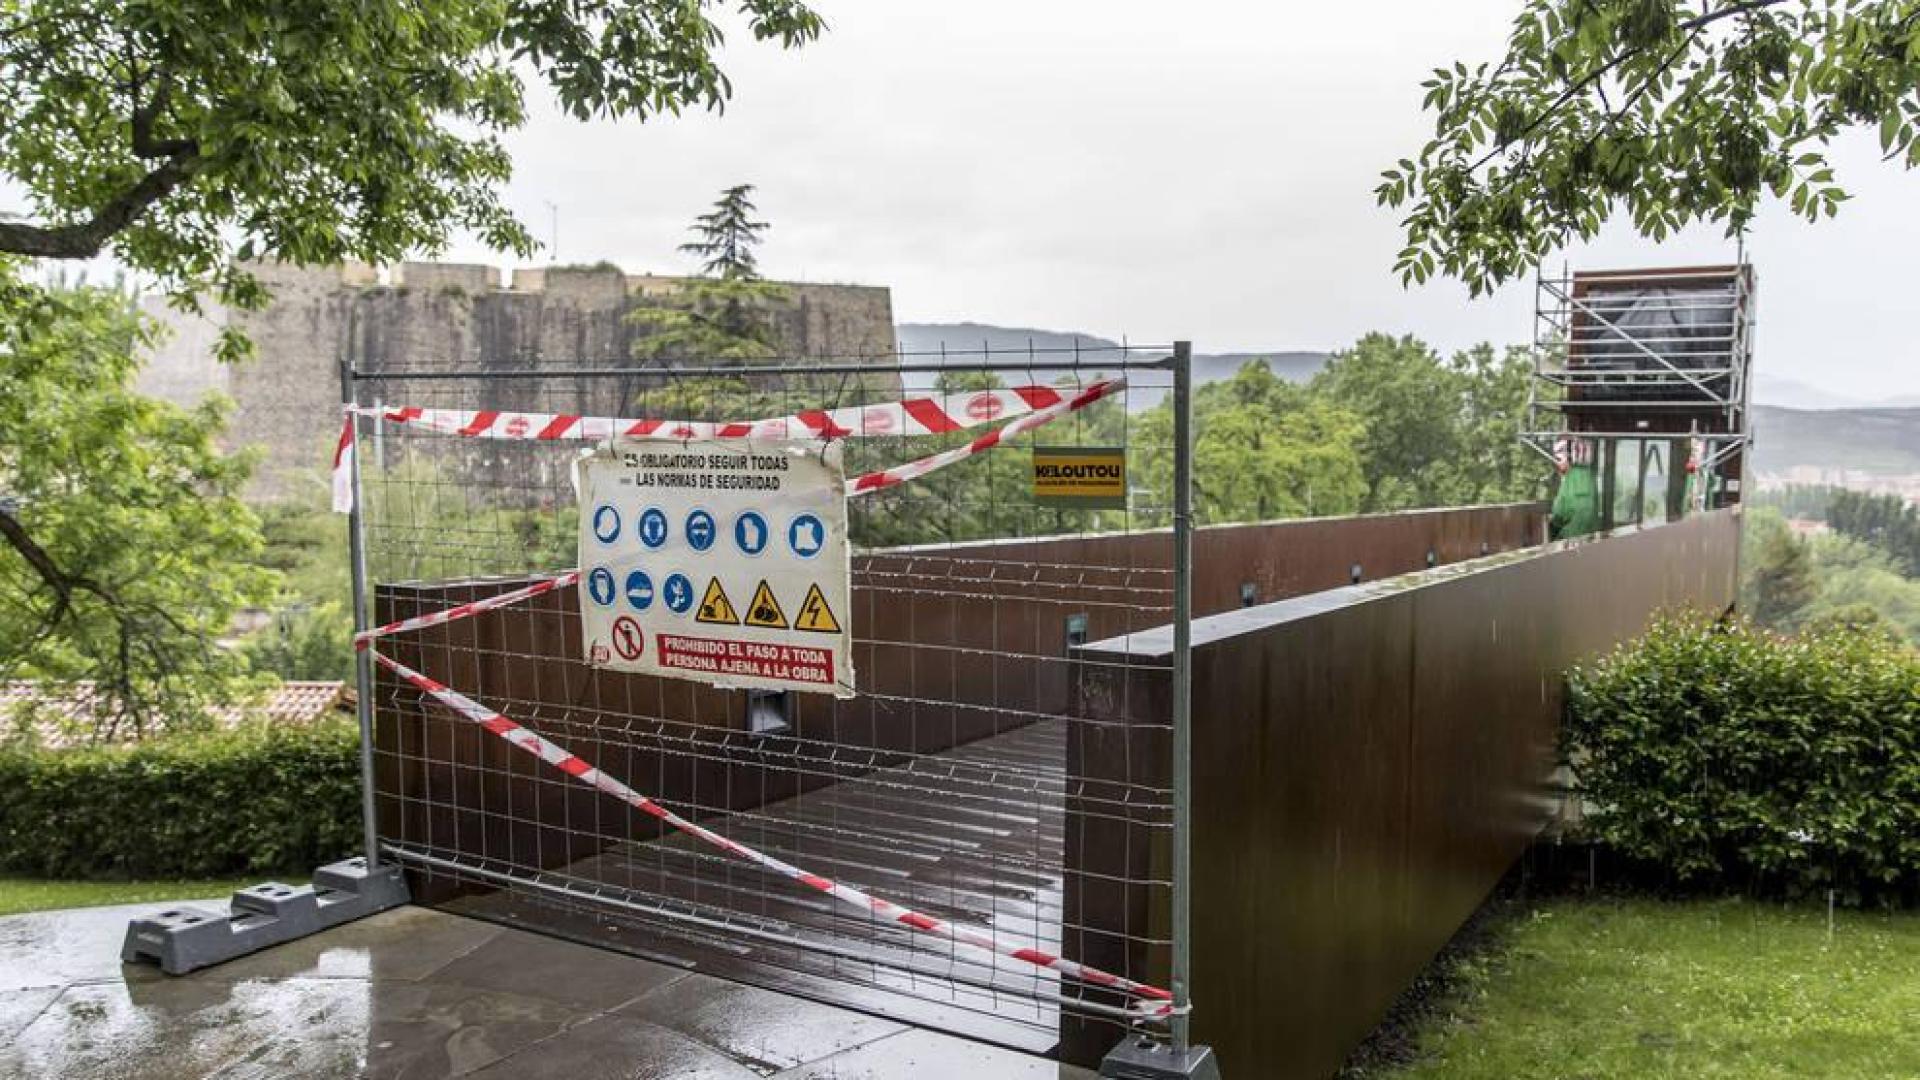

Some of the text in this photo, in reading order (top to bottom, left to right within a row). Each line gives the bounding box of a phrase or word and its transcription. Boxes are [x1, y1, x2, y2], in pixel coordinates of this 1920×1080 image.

[640, 453, 706, 470] OBLIGATORIO
[708, 455, 748, 470] SEGUIR
[751, 455, 788, 471] TODAS
[636, 473, 780, 491] LAS NORMAS DE SEGURIDAD
[664, 637, 827, 664] PROHIBIDO EL PASO A TODA
[666, 653, 828, 681] PERSONA AJENA A LA OBRA
